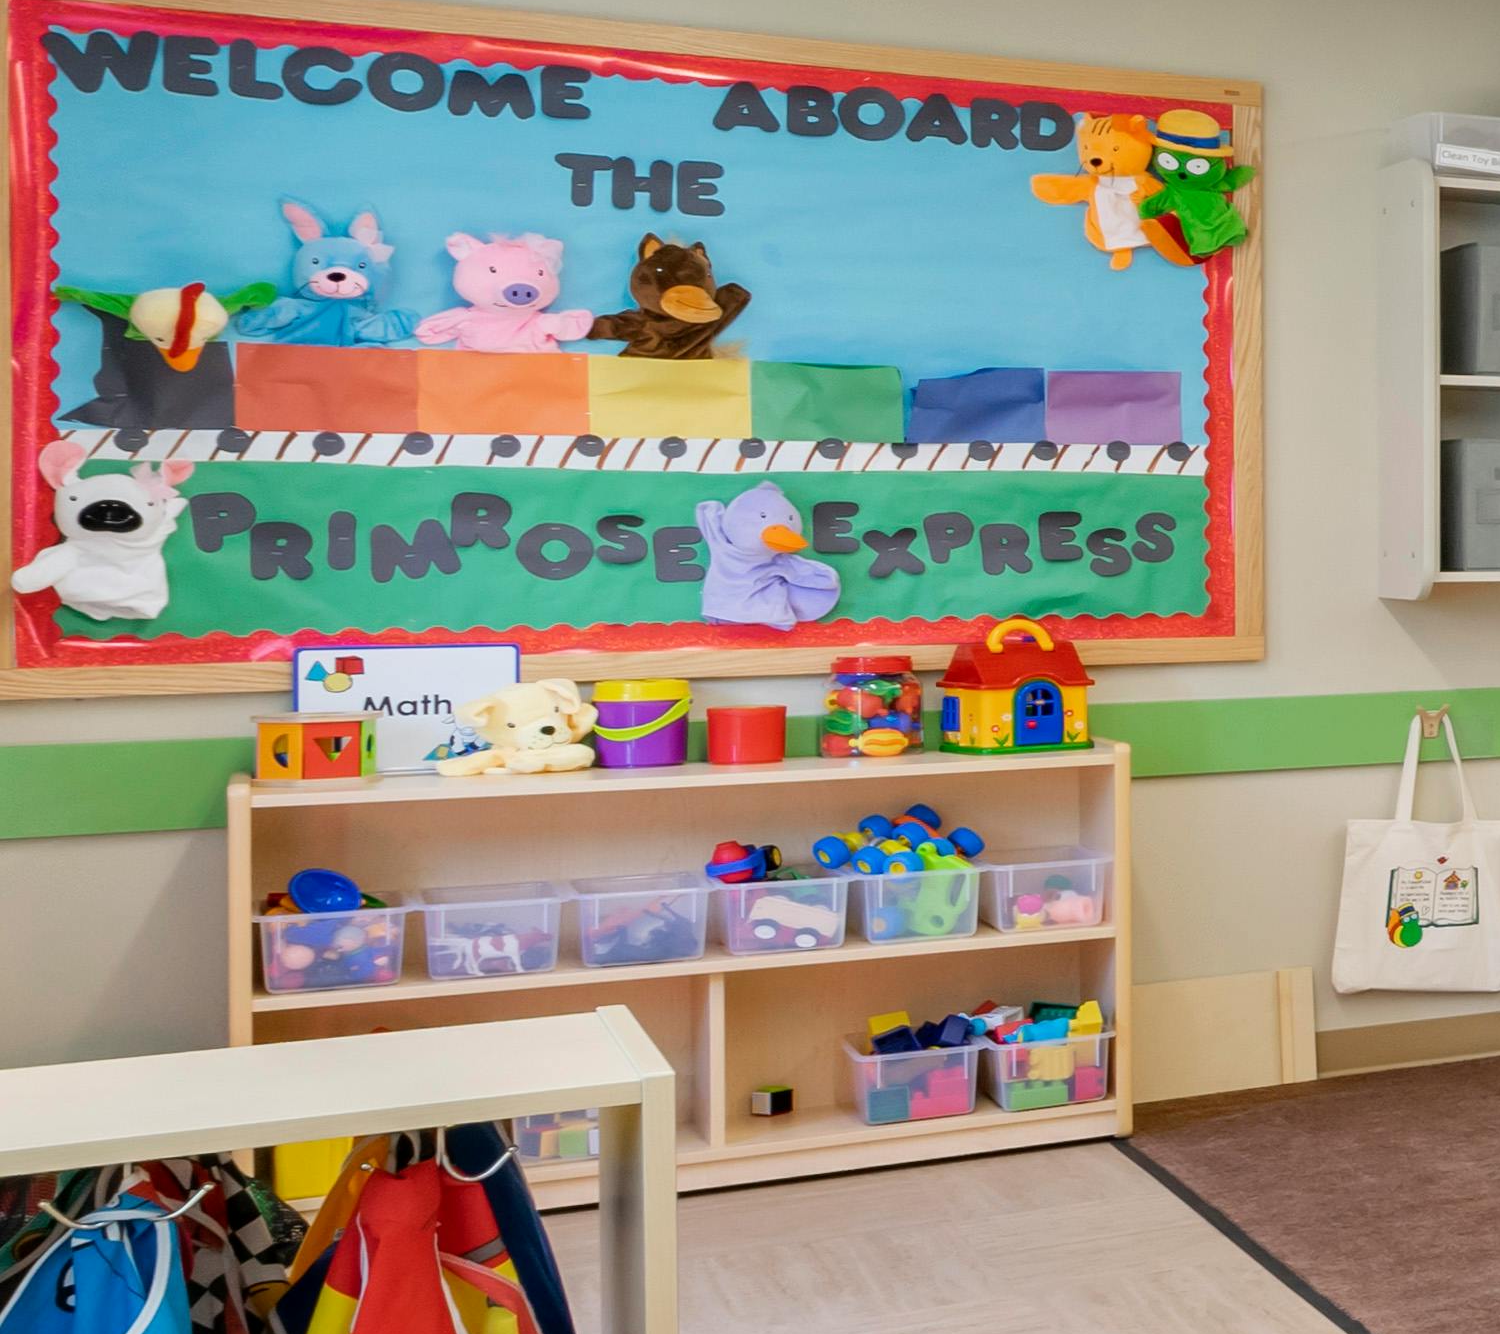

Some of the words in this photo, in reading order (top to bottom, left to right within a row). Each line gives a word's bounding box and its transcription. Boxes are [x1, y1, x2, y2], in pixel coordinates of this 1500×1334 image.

[42, 28, 592, 120] WELCOME
[712, 81, 1077, 153] ABOARD
[555, 153, 725, 218] THE
[1441, 150, 1469, 162] Clean
[1472, 154, 1490, 167] Toy
[189, 491, 704, 584] PRIMROSE
[812, 501, 1177, 579] EXPRESS
[362, 693, 453, 717] Math
